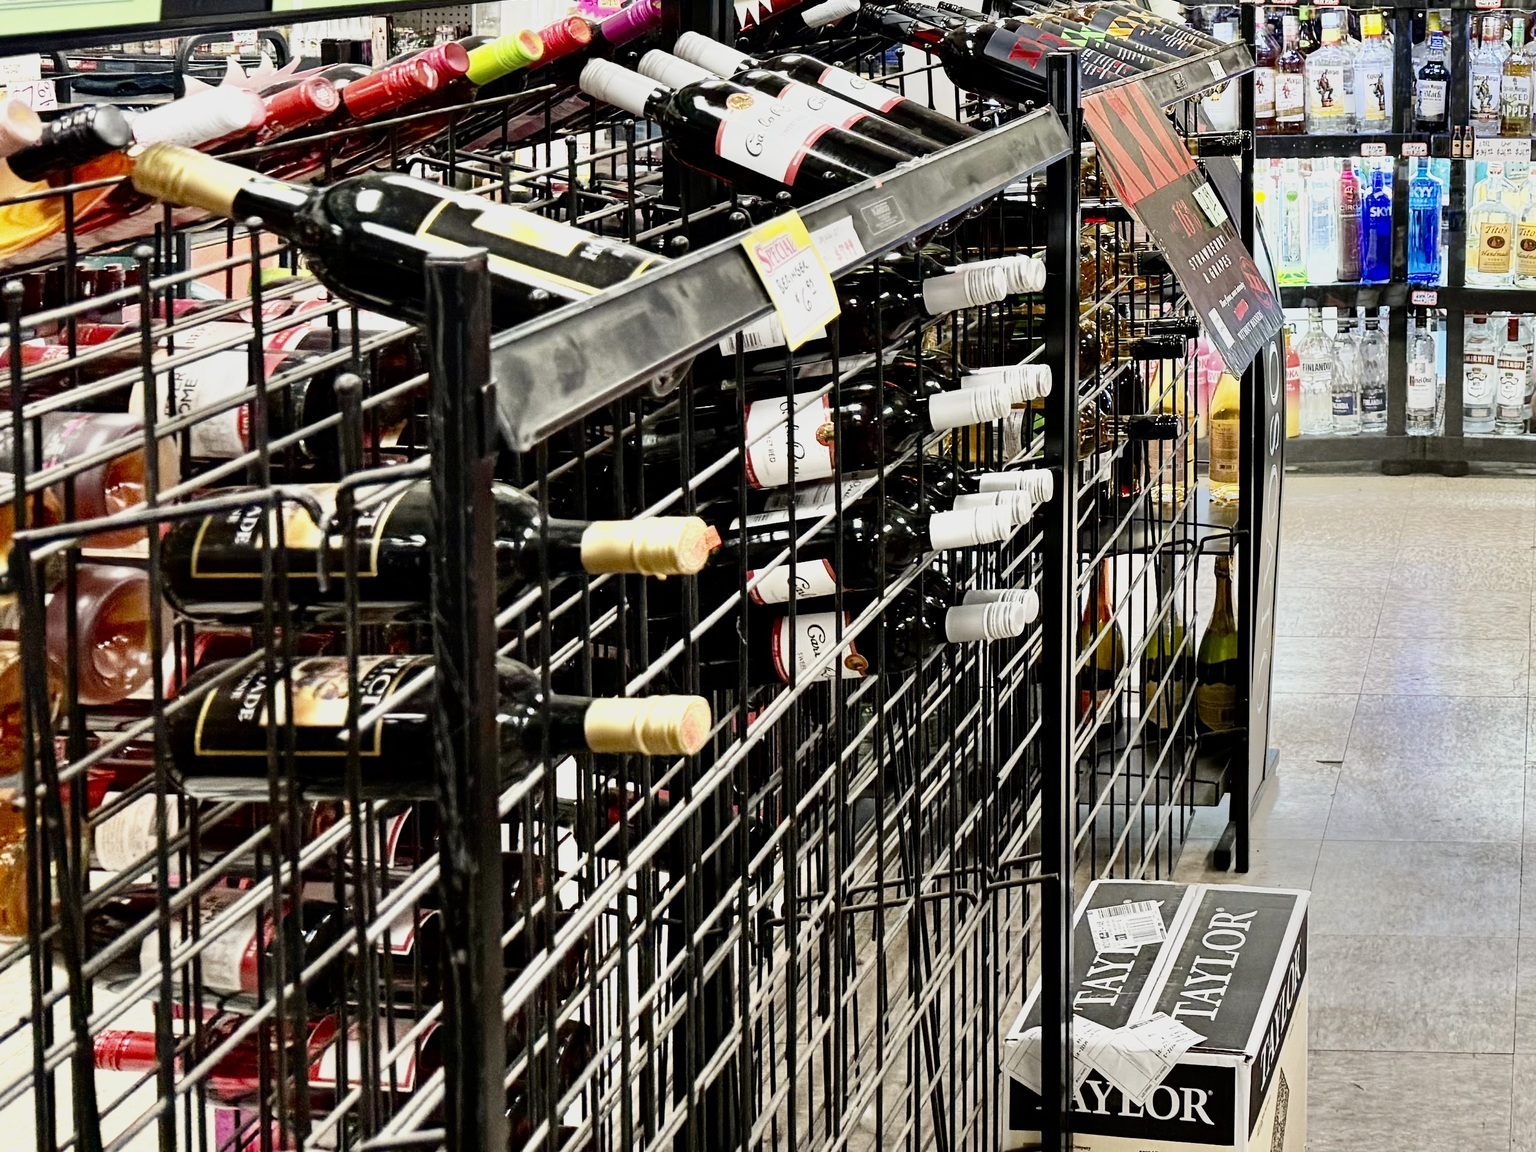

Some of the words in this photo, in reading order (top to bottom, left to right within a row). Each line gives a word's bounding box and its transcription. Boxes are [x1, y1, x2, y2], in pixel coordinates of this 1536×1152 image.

[1502, 105, 1528, 117] APPLE
[1485, 225, 1508, 234] Tito's
[1170, 910, 1259, 1023] TAYLOR
[1072, 1079, 1215, 1126] AYLOR
